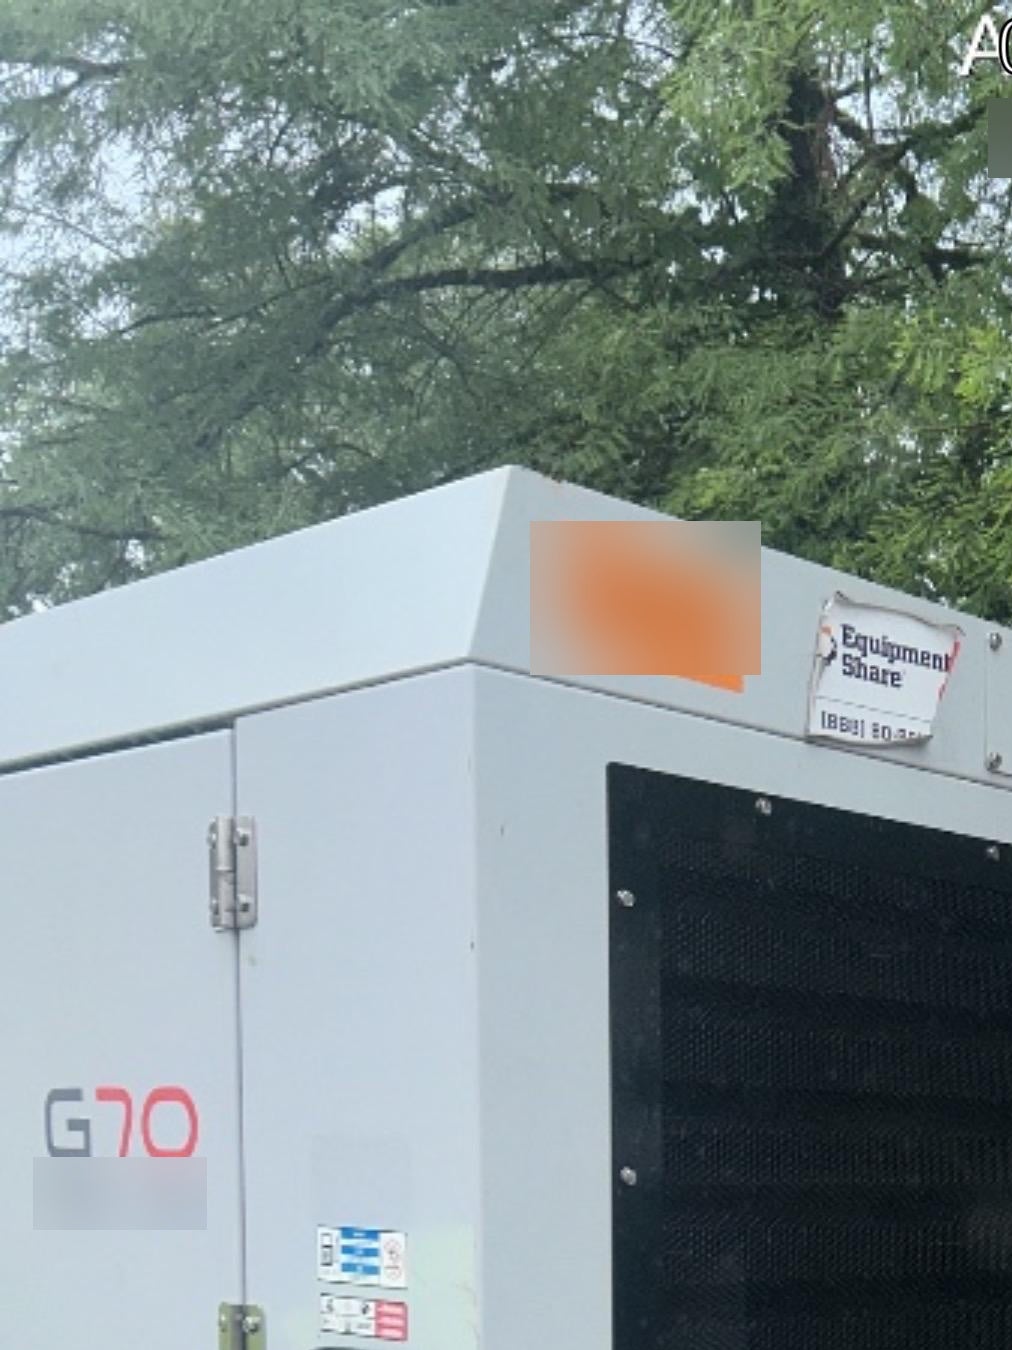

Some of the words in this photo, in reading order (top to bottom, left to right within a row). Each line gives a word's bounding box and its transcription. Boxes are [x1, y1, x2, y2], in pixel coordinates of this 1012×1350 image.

[841, 623, 952, 673] Equipment
[842, 653, 903, 689] Share
[44, 1087, 200, 1158] G70
